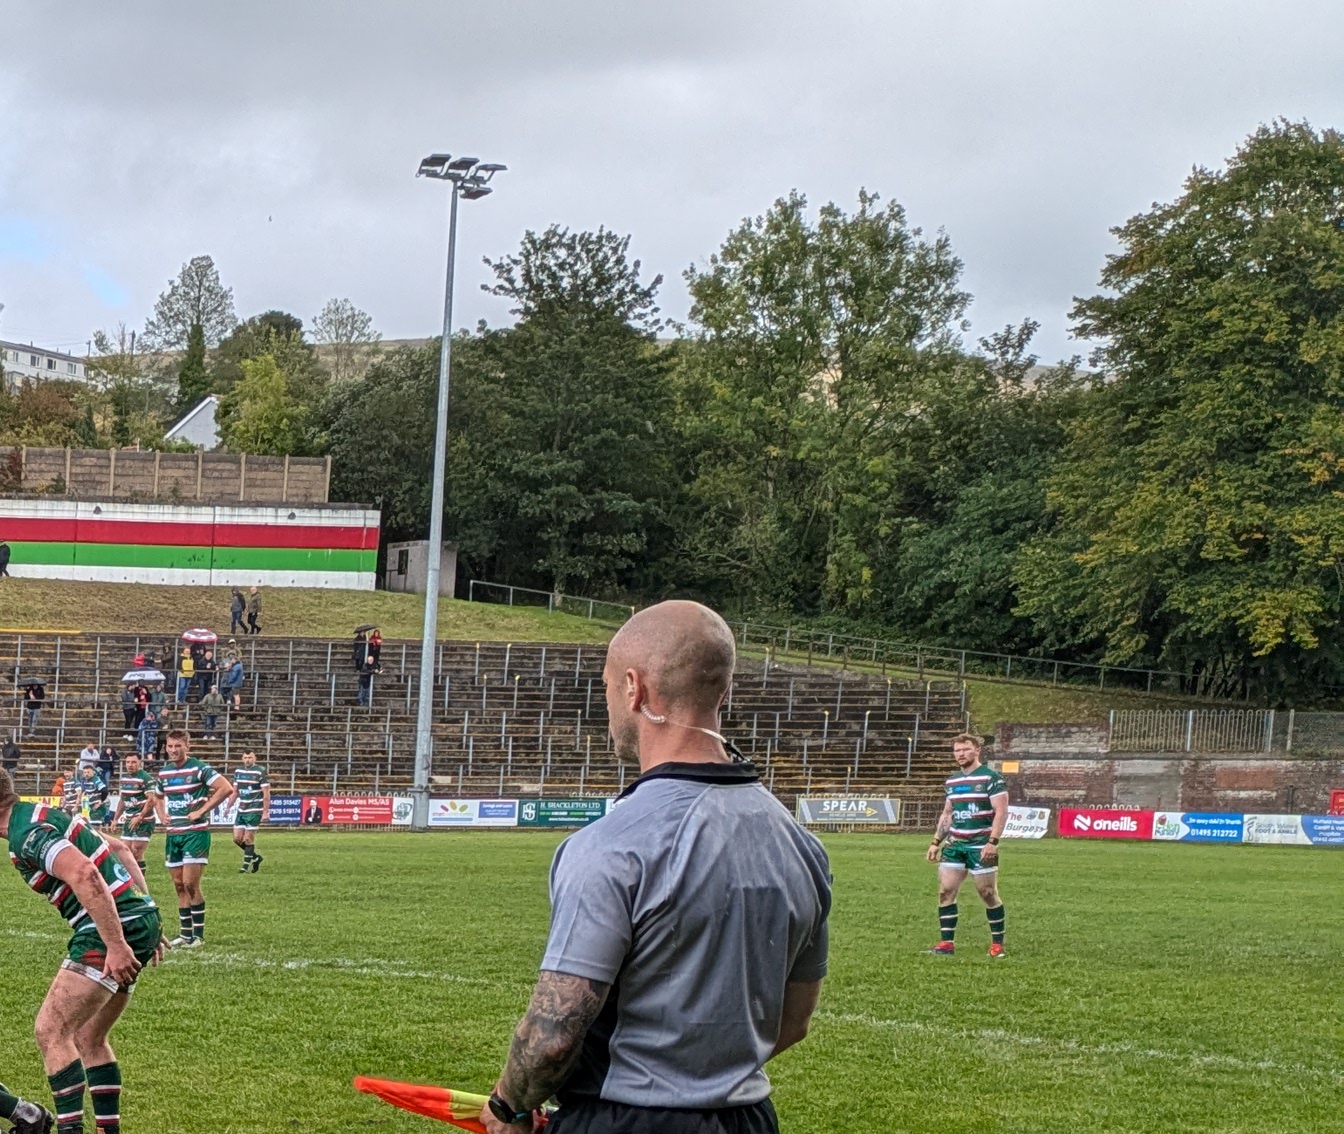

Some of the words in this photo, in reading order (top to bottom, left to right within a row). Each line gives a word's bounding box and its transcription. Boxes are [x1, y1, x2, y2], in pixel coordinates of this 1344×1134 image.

[823, 801, 867, 811] SPEAR
[1007, 812, 1022, 821] The
[1212, 829, 1238, 837] 212722
